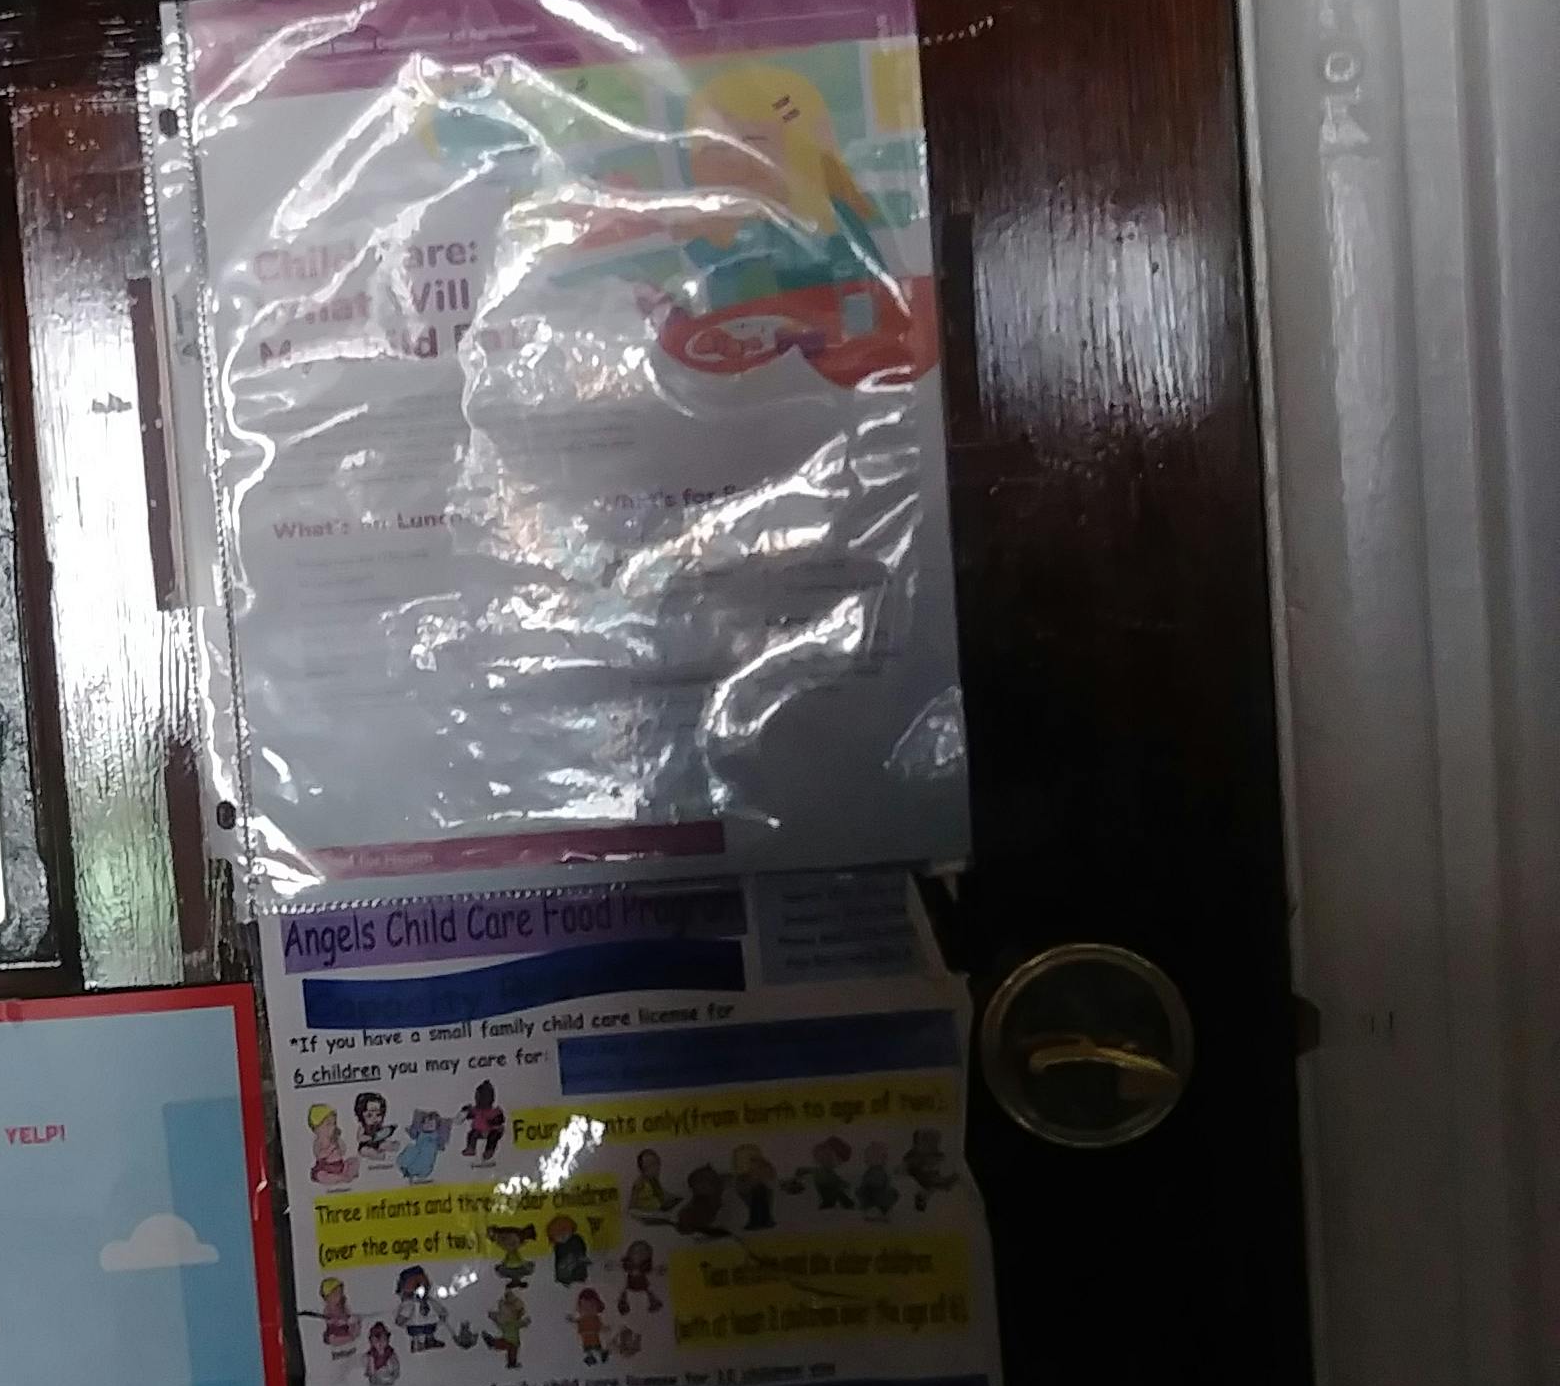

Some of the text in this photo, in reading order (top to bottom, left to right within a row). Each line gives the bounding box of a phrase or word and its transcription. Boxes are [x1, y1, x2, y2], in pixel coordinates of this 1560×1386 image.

[284, 920, 376, 967] Angels
[386, 908, 457, 949] Child
[467, 906, 534, 941] Care
[543, 898, 613, 935] Food
[326, 1035, 356, 1055] you
[363, 1028, 402, 1047] have
[411, 1031, 421, 1043] a
[429, 1019, 472, 1041] small
[481, 1016, 535, 1040] family
[542, 1011, 584, 1032] child
[591, 1012, 631, 1028] care
[293, 1066, 305, 1085] 6
[311, 1060, 381, 1084] children
[388, 1062, 418, 1081] you
[425, 1058, 460, 1077] may
[468, 1051, 507, 1068] care
[4, 1124, 66, 1146] YELP!
[316, 1193, 452, 1225] Three infants and
[362, 1236, 388, 1256] the
[391, 1237, 419, 1260] age
[424, 1230, 440, 1253] of
